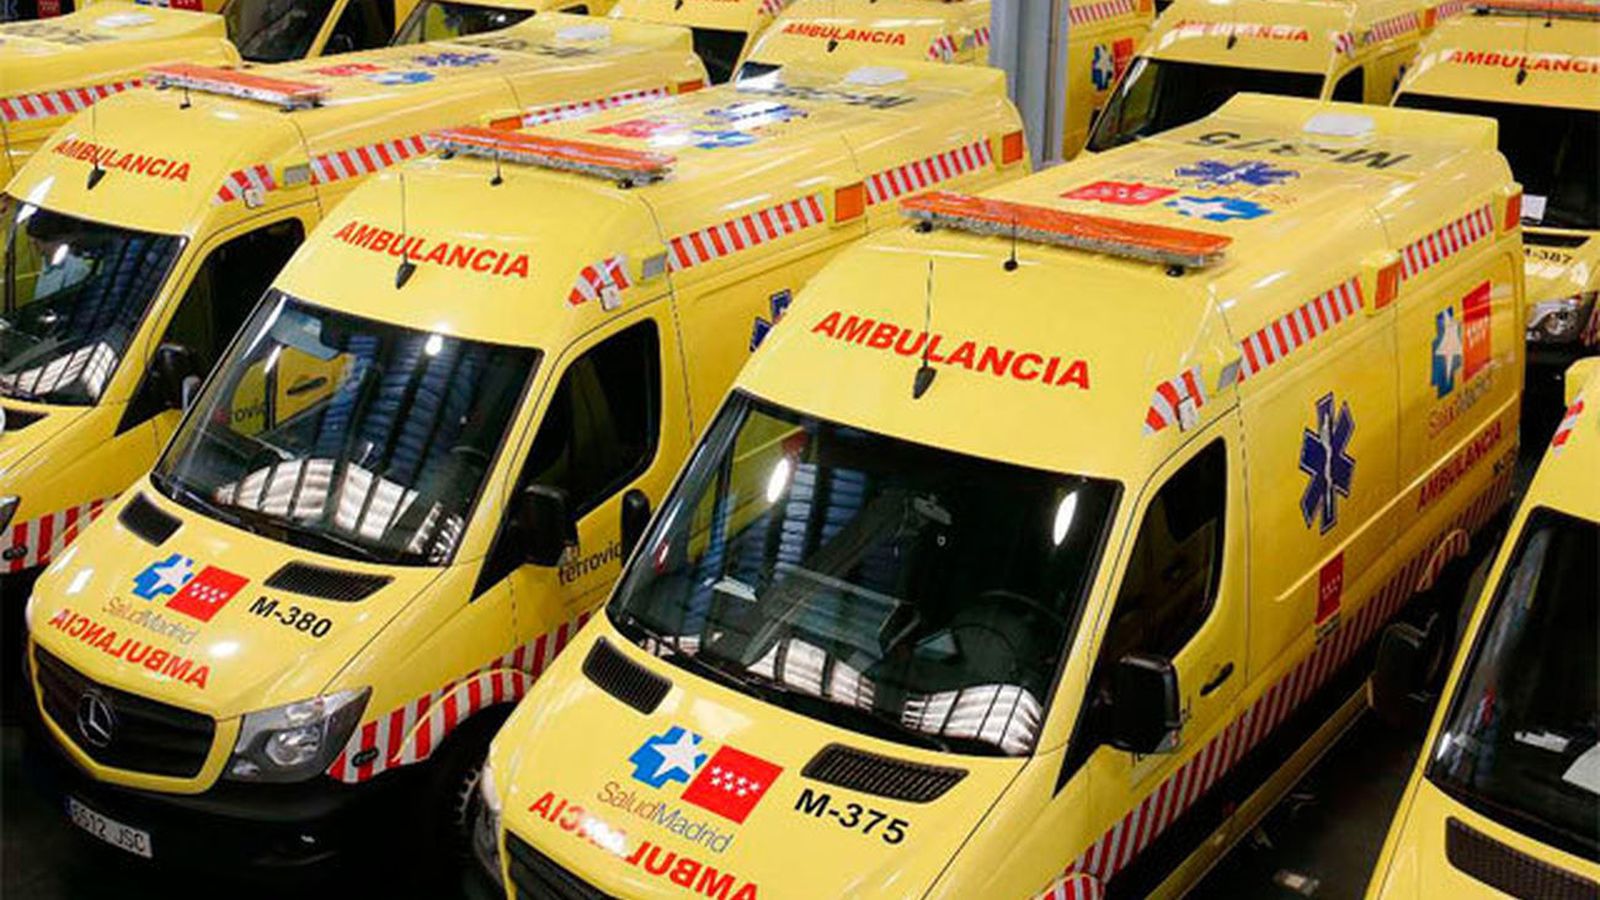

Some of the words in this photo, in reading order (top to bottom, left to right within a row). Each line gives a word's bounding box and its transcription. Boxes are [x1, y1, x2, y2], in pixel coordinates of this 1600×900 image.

[782, 23, 905, 46] AMBULANCIA
[1450, 50, 1600, 74] AMBULANCI
[52, 138, 191, 182] AMBULANCIA
[334, 220, 529, 278] AMBULANCIA
[812, 310, 1091, 390] AMBULANCIA
[558, 540, 621, 587] ferrovia
[248, 595, 333, 638] M-380
[597, 780, 735, 854] SaludMadrid
[794, 787, 910, 845] M-375
